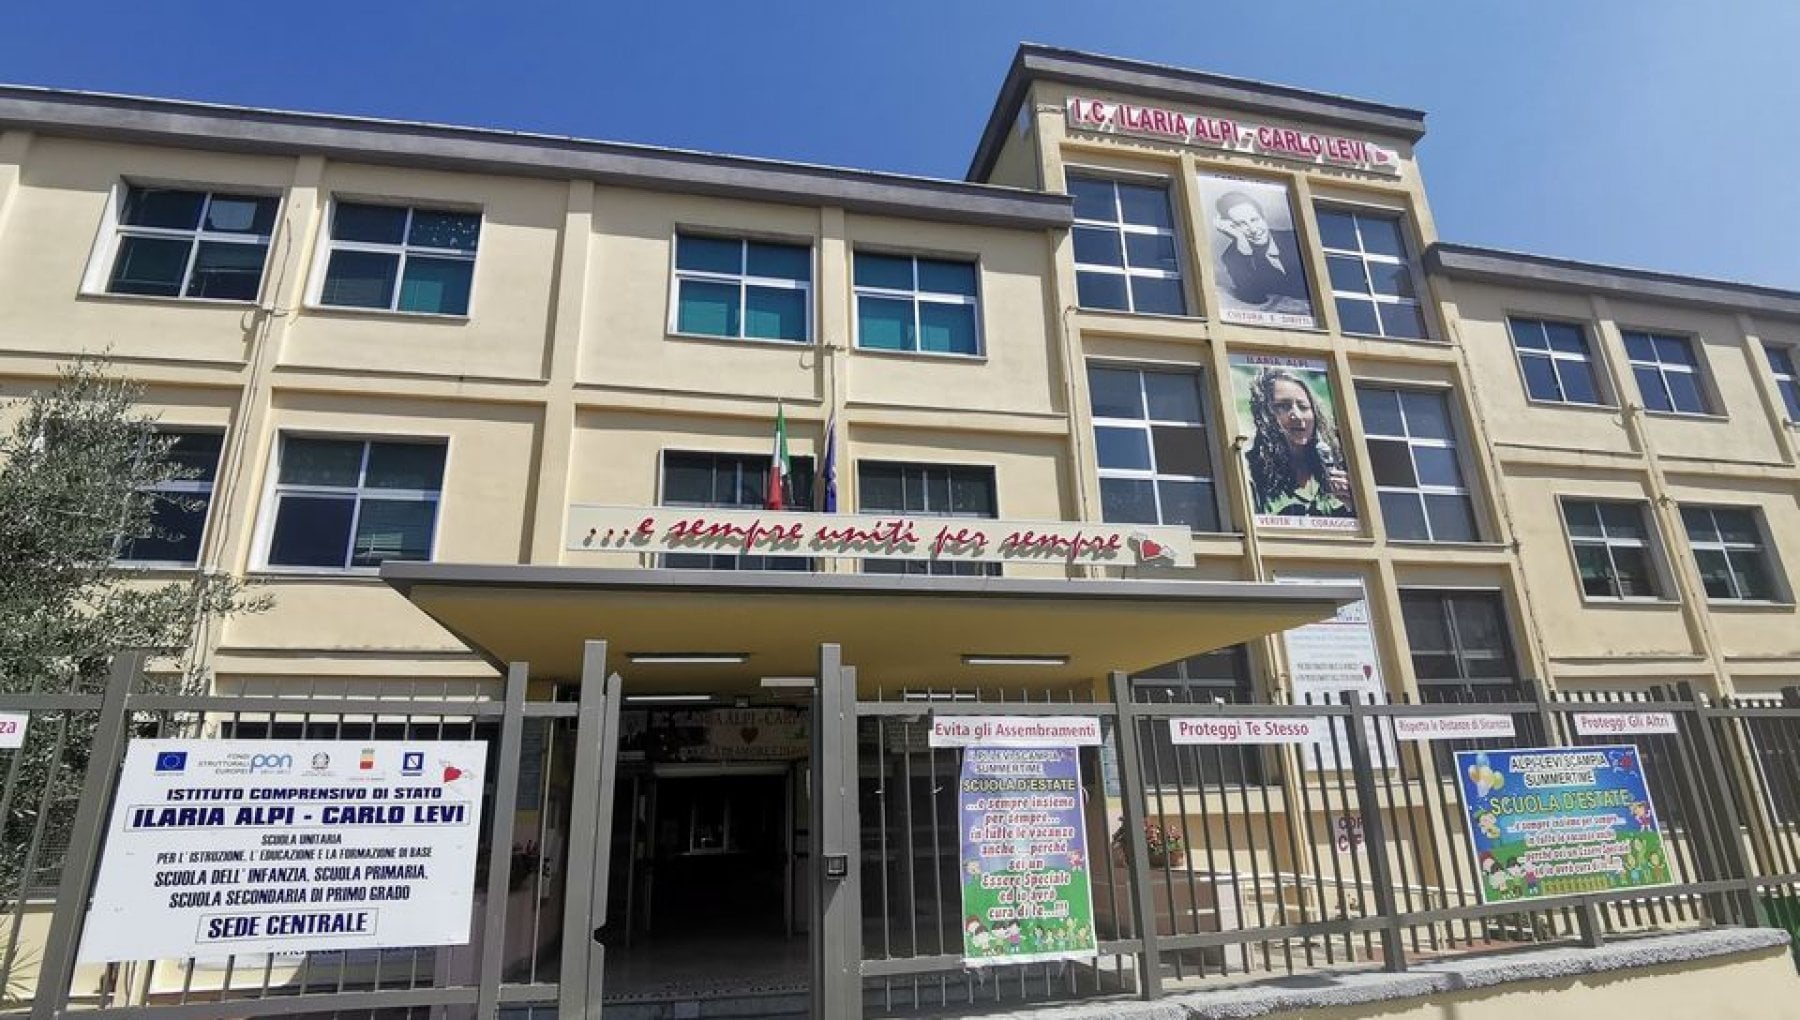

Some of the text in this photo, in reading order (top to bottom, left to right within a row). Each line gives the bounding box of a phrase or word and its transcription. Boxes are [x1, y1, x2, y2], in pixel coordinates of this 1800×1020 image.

[1074, 99, 1113, 124] I.C.
[1120, 105, 1188, 137] ILARIA
[1195, 117, 1240, 143] ALPI
[1259, 127, 1322, 156] CARLO
[1327, 138, 1369, 162] LEVI
[667, 518, 804, 548] sempre
[816, 519, 919, 543] uniti
[935, 524, 988, 554] per
[1004, 530, 1122, 559] sempre
[1179, 721, 1310, 740] Proteggi Te Stesso
[1581, 714, 1670, 732] Proteggi Gli Altri
[935, 723, 1096, 740] Evita gli Assembramenti
[250, 753, 293, 774] pon
[977, 763, 1042, 775] SUMMERTIME
[1511, 753, 1607, 769] ALPI-LEVI SCAMPIA
[962, 778, 1076, 792] SCUOLA D'ESTATE
[1526, 770, 1595, 787] SUMMERTIME
[167, 786, 442, 801] ISTITUTO COMPRENSIVO DI STATO
[988, 799, 1029, 811] sempre
[1032, 796, 1075, 808] insieme
[1490, 790, 1631, 816] SCUOLA D'ESTATE
[133, 807, 225, 828] ILARIA
[234, 806, 295, 826] ALPI
[322, 805, 405, 824] CARLO
[414, 804, 465, 824] LEVI
[985, 814, 1004, 826] per
[261, 833, 342, 846] SCUOLA UNITARIA
[970, 826, 1075, 839] in tutte le vacanze
[157, 852, 177, 864] PER
[260, 848, 316, 861] EDUCAZIONE
[318, 848, 323, 859] E
[326, 848, 337, 860] LA
[339, 846, 396, 860] FORMAZIONE
[398, 847, 408, 858] DI
[409, 846, 432, 858] BASE
[982, 842, 1015, 854] anche
[1028, 859, 1044, 870] un
[154, 869, 207, 887] SCUOLA
[314, 865, 361, 882] SCUOLA
[982, 871, 1070, 887] Essere Speciale
[169, 885, 411, 908] SCUOLA SECONDARIA DI PRIMO GRADO
[1000, 888, 1014, 900] ed
[989, 906, 1014, 918] cura
[1017, 903, 1029, 917] di
[208, 912, 368, 938] SEDE CENTRALE
